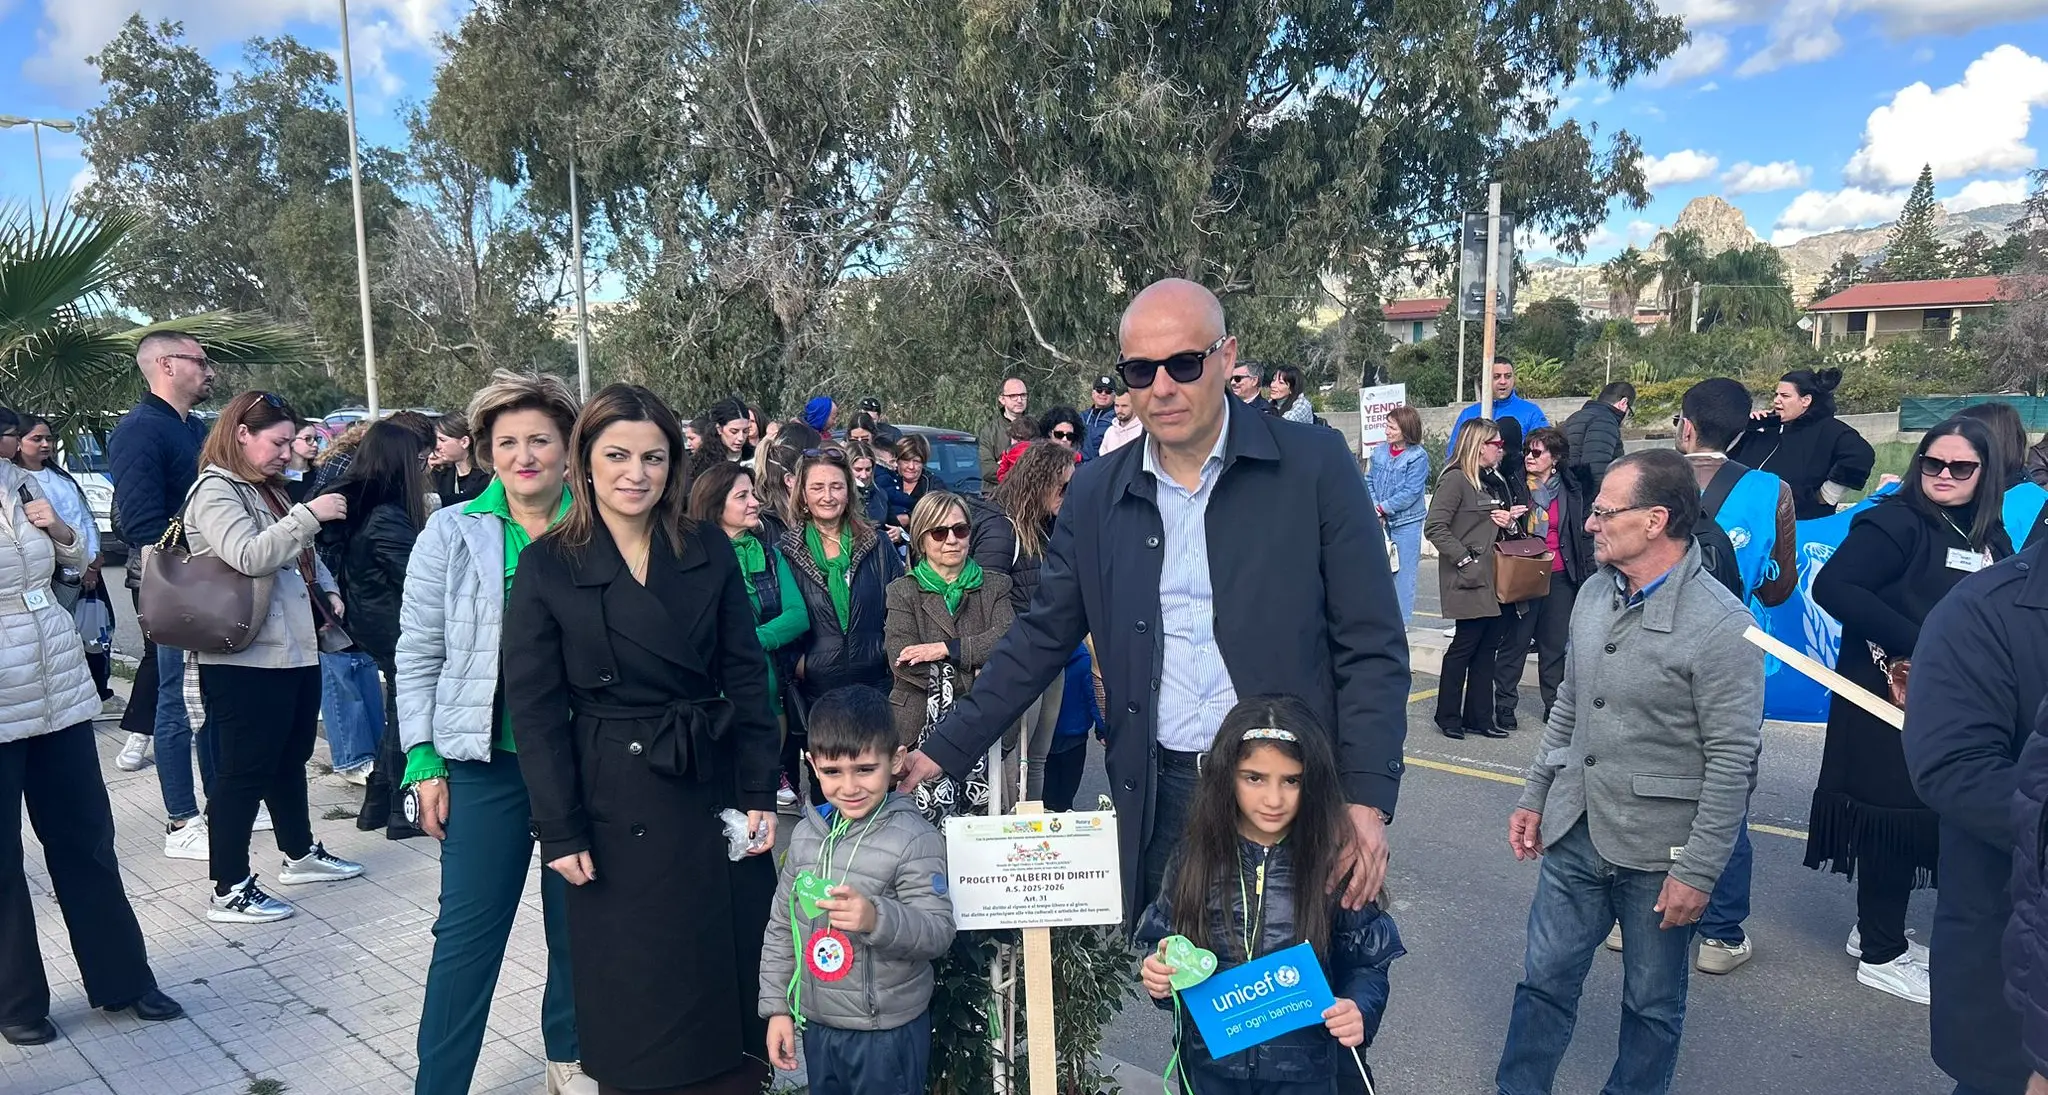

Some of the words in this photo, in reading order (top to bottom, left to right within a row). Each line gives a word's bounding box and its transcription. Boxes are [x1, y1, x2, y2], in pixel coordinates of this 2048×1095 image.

[1364, 401, 1402, 414] VENDE
[1366, 414, 1388, 423] TERR
[1364, 422, 1388, 430] EDIFIC
[959, 874, 1008, 885] PROGETTO
[1010, 872, 1052, 883] "ALBERI
[1054, 871, 1065, 881] DI
[1067, 870, 1110, 880] DIRITTI"
[1005, 885, 1020, 893] A.S.
[1023, 884, 1065, 892] 2025-2026
[1212, 970, 1276, 1013] unicef
[1225, 1021, 1242, 1039] per
[1246, 1013, 1268, 1030] ogni
[1269, 998, 1313, 1020] bambino
